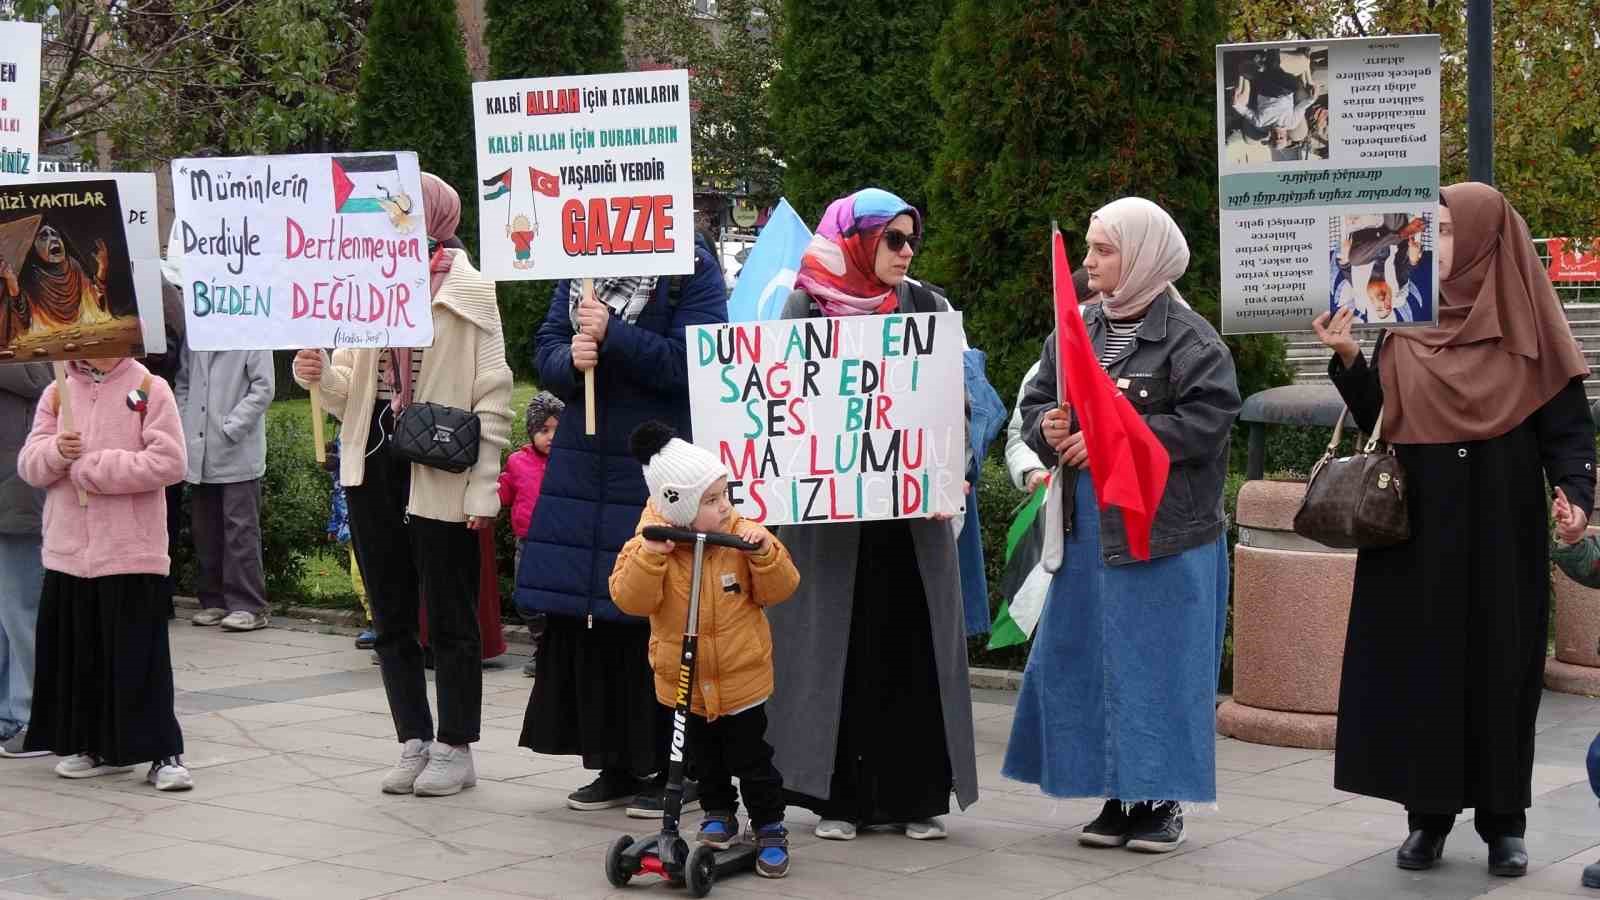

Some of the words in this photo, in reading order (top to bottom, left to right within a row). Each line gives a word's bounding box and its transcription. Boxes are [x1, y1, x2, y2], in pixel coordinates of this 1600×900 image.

[1388, 66, 1432, 79] gelecek
[485, 91, 522, 115] KALBİ
[526, 88, 580, 116] ALLAH
[582, 86, 608, 114] İÇİN
[612, 84, 680, 107] ATANLARIN
[487, 131, 524, 154] KALBİ
[526, 133, 566, 153] ALLAH
[569, 127, 596, 155] İÇİN
[599, 125, 679, 149] DURANLARIN
[1359, 149, 1407, 159] Binlerce
[0, 146, 31, 175] İNİZ
[560, 160, 617, 191] YAŞADIĞI
[619, 157, 666, 182] YERDİR
[30, 191, 107, 209] YAKTILAR
[127, 209, 149, 225] DE
[561, 194, 676, 258] GAZZE
[181, 216, 262, 275] Derdiyle
[286, 216, 422, 279] Dertlenmeyen
[1295, 256, 1309, 264] on
[192, 276, 273, 319] BİZDEN
[697, 317, 866, 368] DÜNYANIN
[882, 314, 937, 357] EN
[846, 393, 894, 432] BİR
